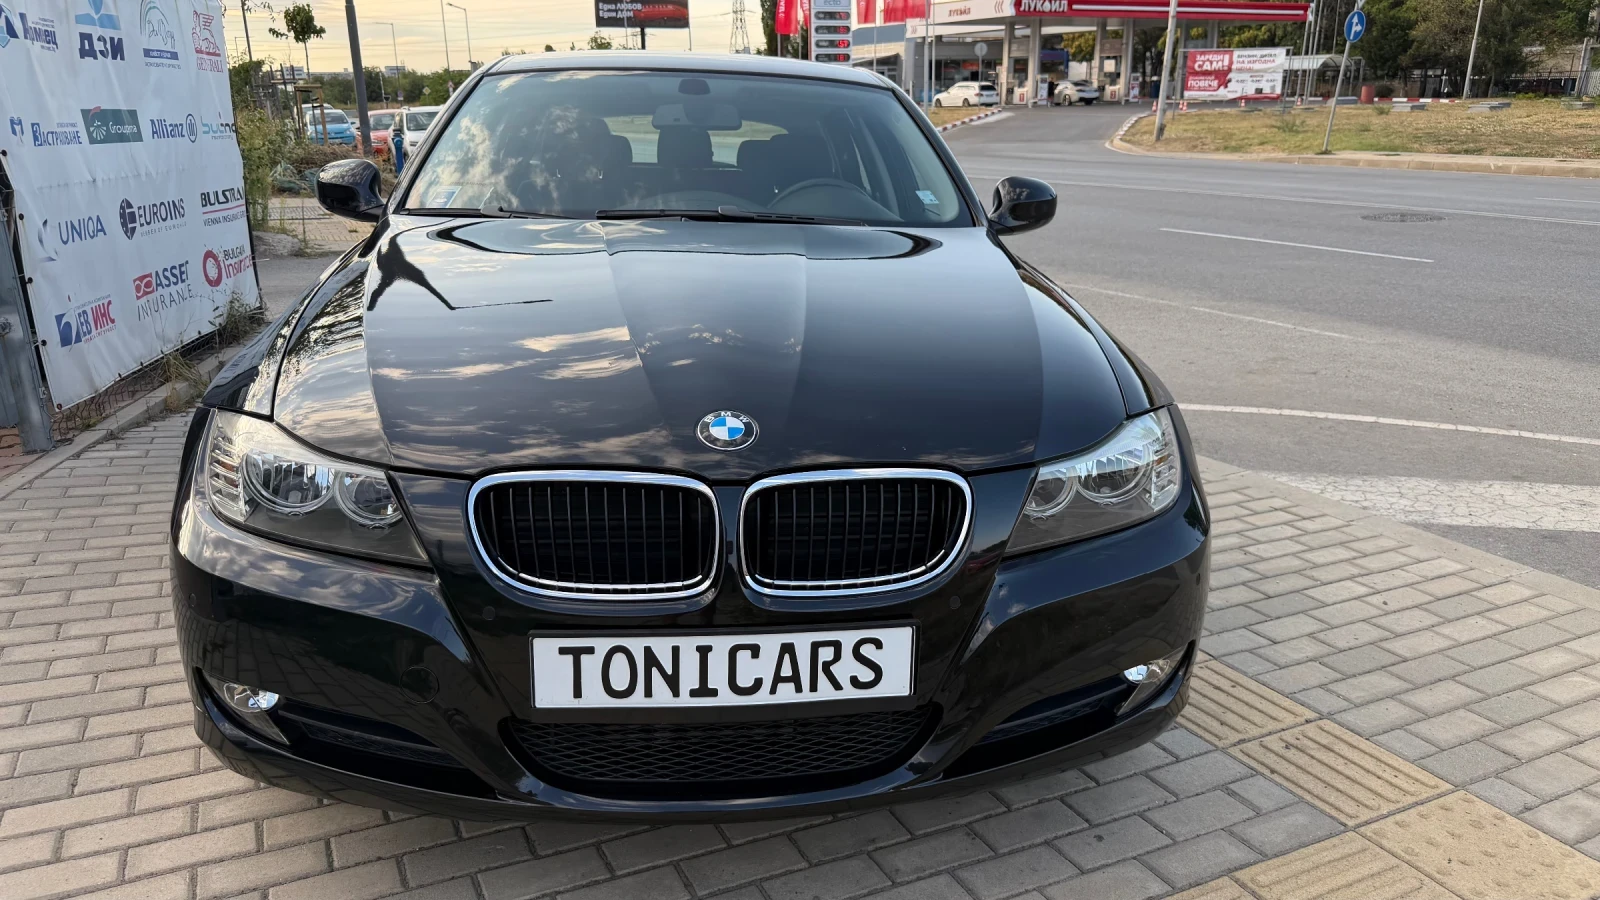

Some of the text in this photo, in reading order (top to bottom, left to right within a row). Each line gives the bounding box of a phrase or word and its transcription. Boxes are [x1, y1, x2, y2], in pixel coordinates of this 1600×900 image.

[78, 32, 125, 61] ДЗИ
[150, 118, 185, 139] Allianz
[138, 198, 185, 227] EUROINS
[58, 214, 107, 245] UNIQA
[91, 300, 116, 331] ИНС
[704, 411, 750, 423] BMW
[558, 637, 884, 699] TONICARS
